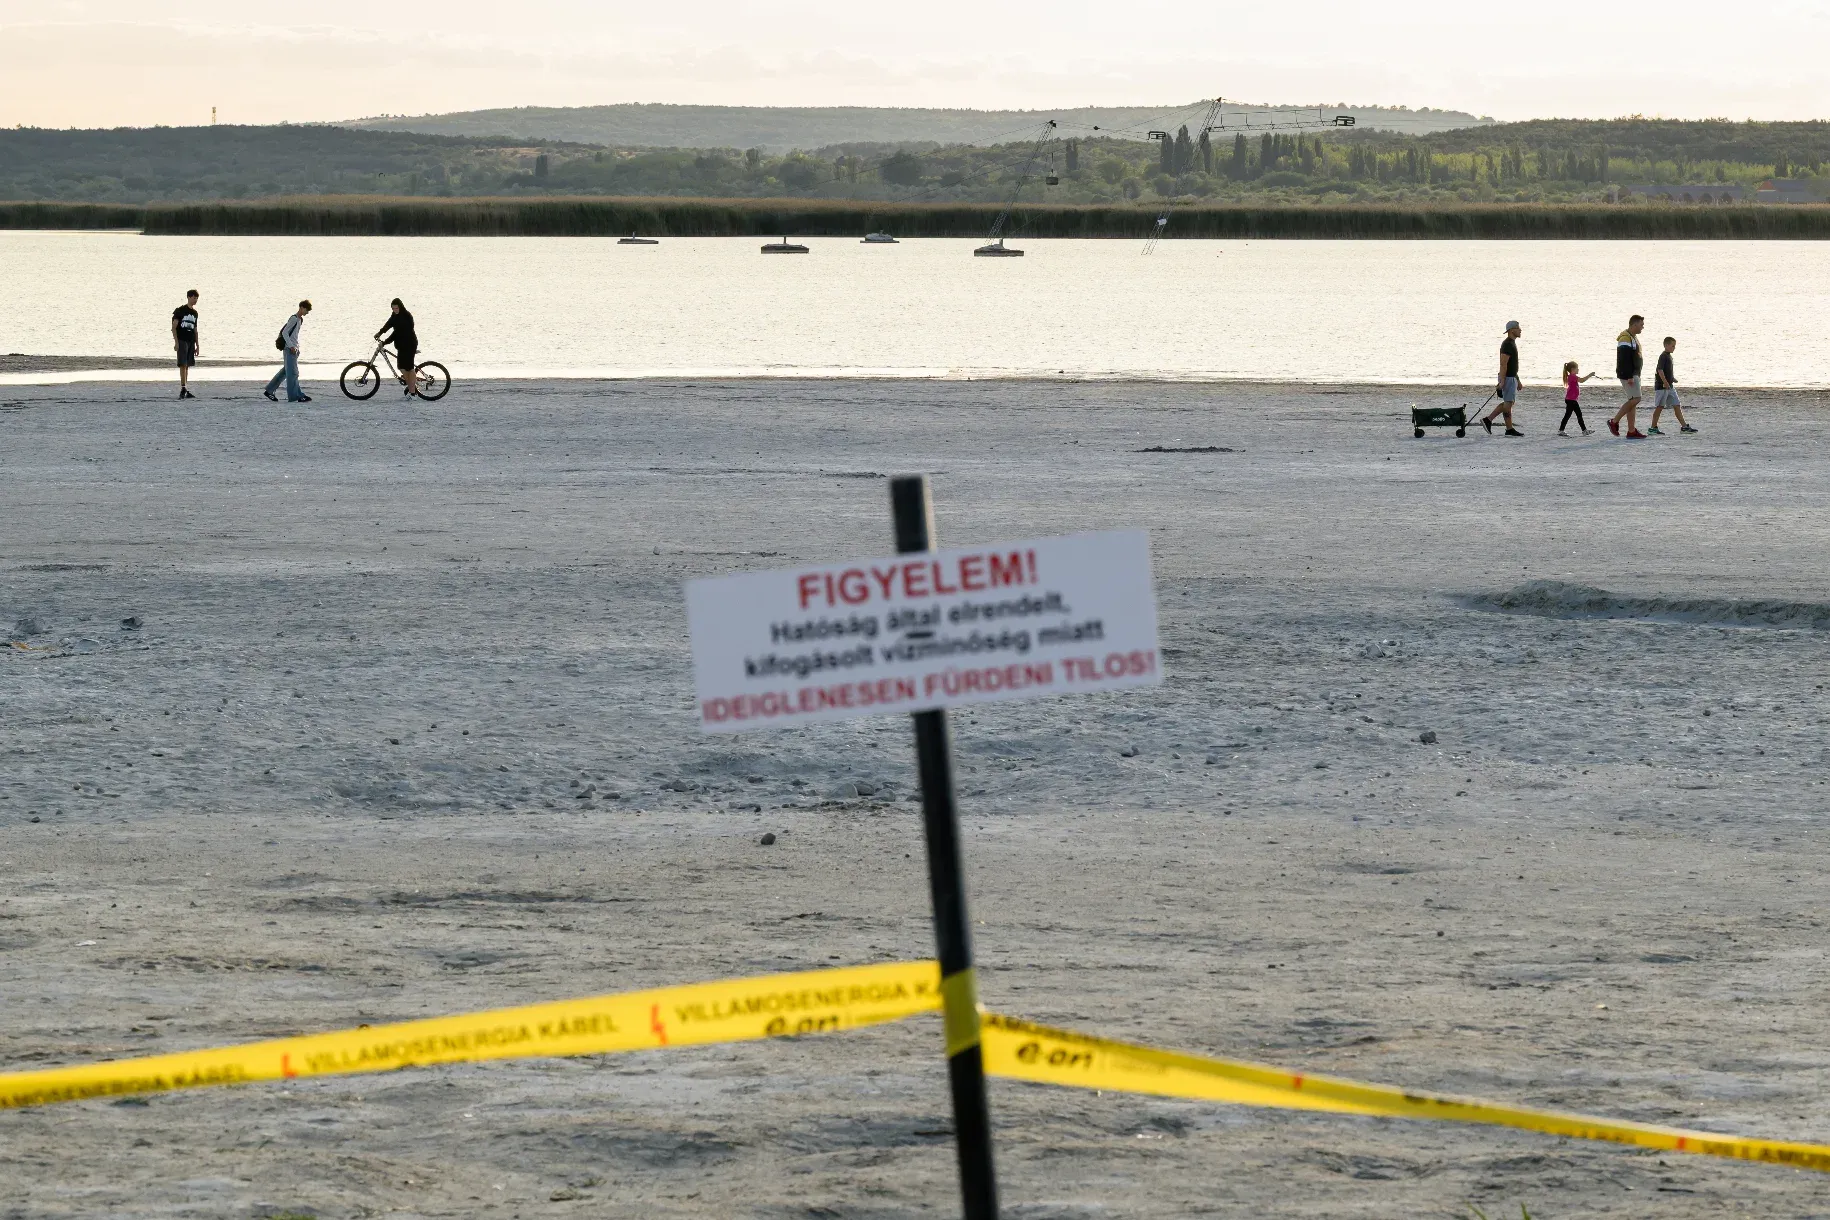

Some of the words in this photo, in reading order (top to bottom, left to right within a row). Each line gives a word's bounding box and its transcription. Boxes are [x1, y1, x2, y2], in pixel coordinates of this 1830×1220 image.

[797, 547, 1039, 609] FIGYELEM!
[770, 614, 878, 644] Hatóság
[886, 602, 941, 632] által
[1037, 618, 1104, 646] miatt
[702, 678, 916, 722] IDEIGLENESEN
[923, 662, 1053, 698] FÜRDENI
[1061, 650, 1157, 683] TILOS!
[674, 982, 908, 1022] VILLAMOSENERGIA
[304, 1024, 531, 1072] VILLAMOSENERGIA
[537, 1012, 620, 1040] KÁBEL
